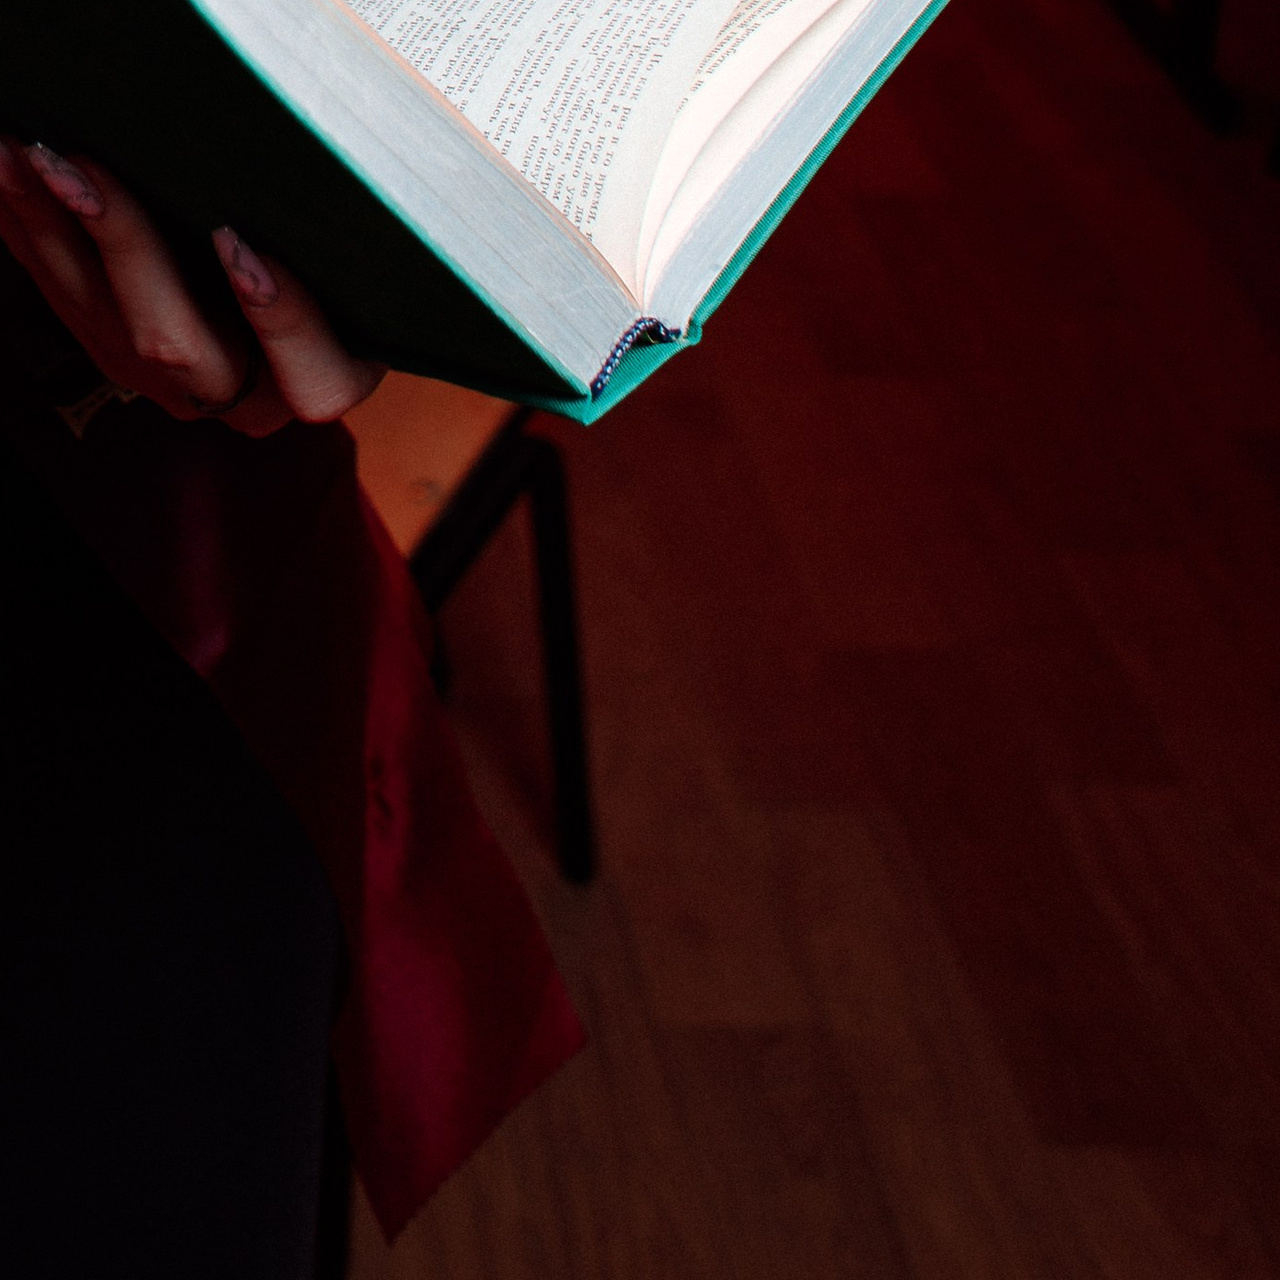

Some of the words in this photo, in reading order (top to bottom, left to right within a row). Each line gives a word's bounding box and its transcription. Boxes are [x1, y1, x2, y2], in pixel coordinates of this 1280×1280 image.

[580, 27, 598, 49] что
[611, 14, 633, 41] весь
[614, 28, 636, 56] себе
[599, 42, 641, 107] Беликова
[617, 35, 659, 98] Варенька
[539, 57, 579, 124] прикажут
[628, 75, 647, 101] как
[545, 73, 581, 142] нарисуют
[560, 85, 587, 135] дойдет
[578, 97, 595, 123] обе
[587, 109, 602, 136] это
[615, 104, 632, 131] раз
[571, 138, 592, 180] было
[589, 133, 606, 166] нею
[552, 169, 566, 204] чем
[579, 169, 592, 200] две
[573, 202, 584, 231] да
